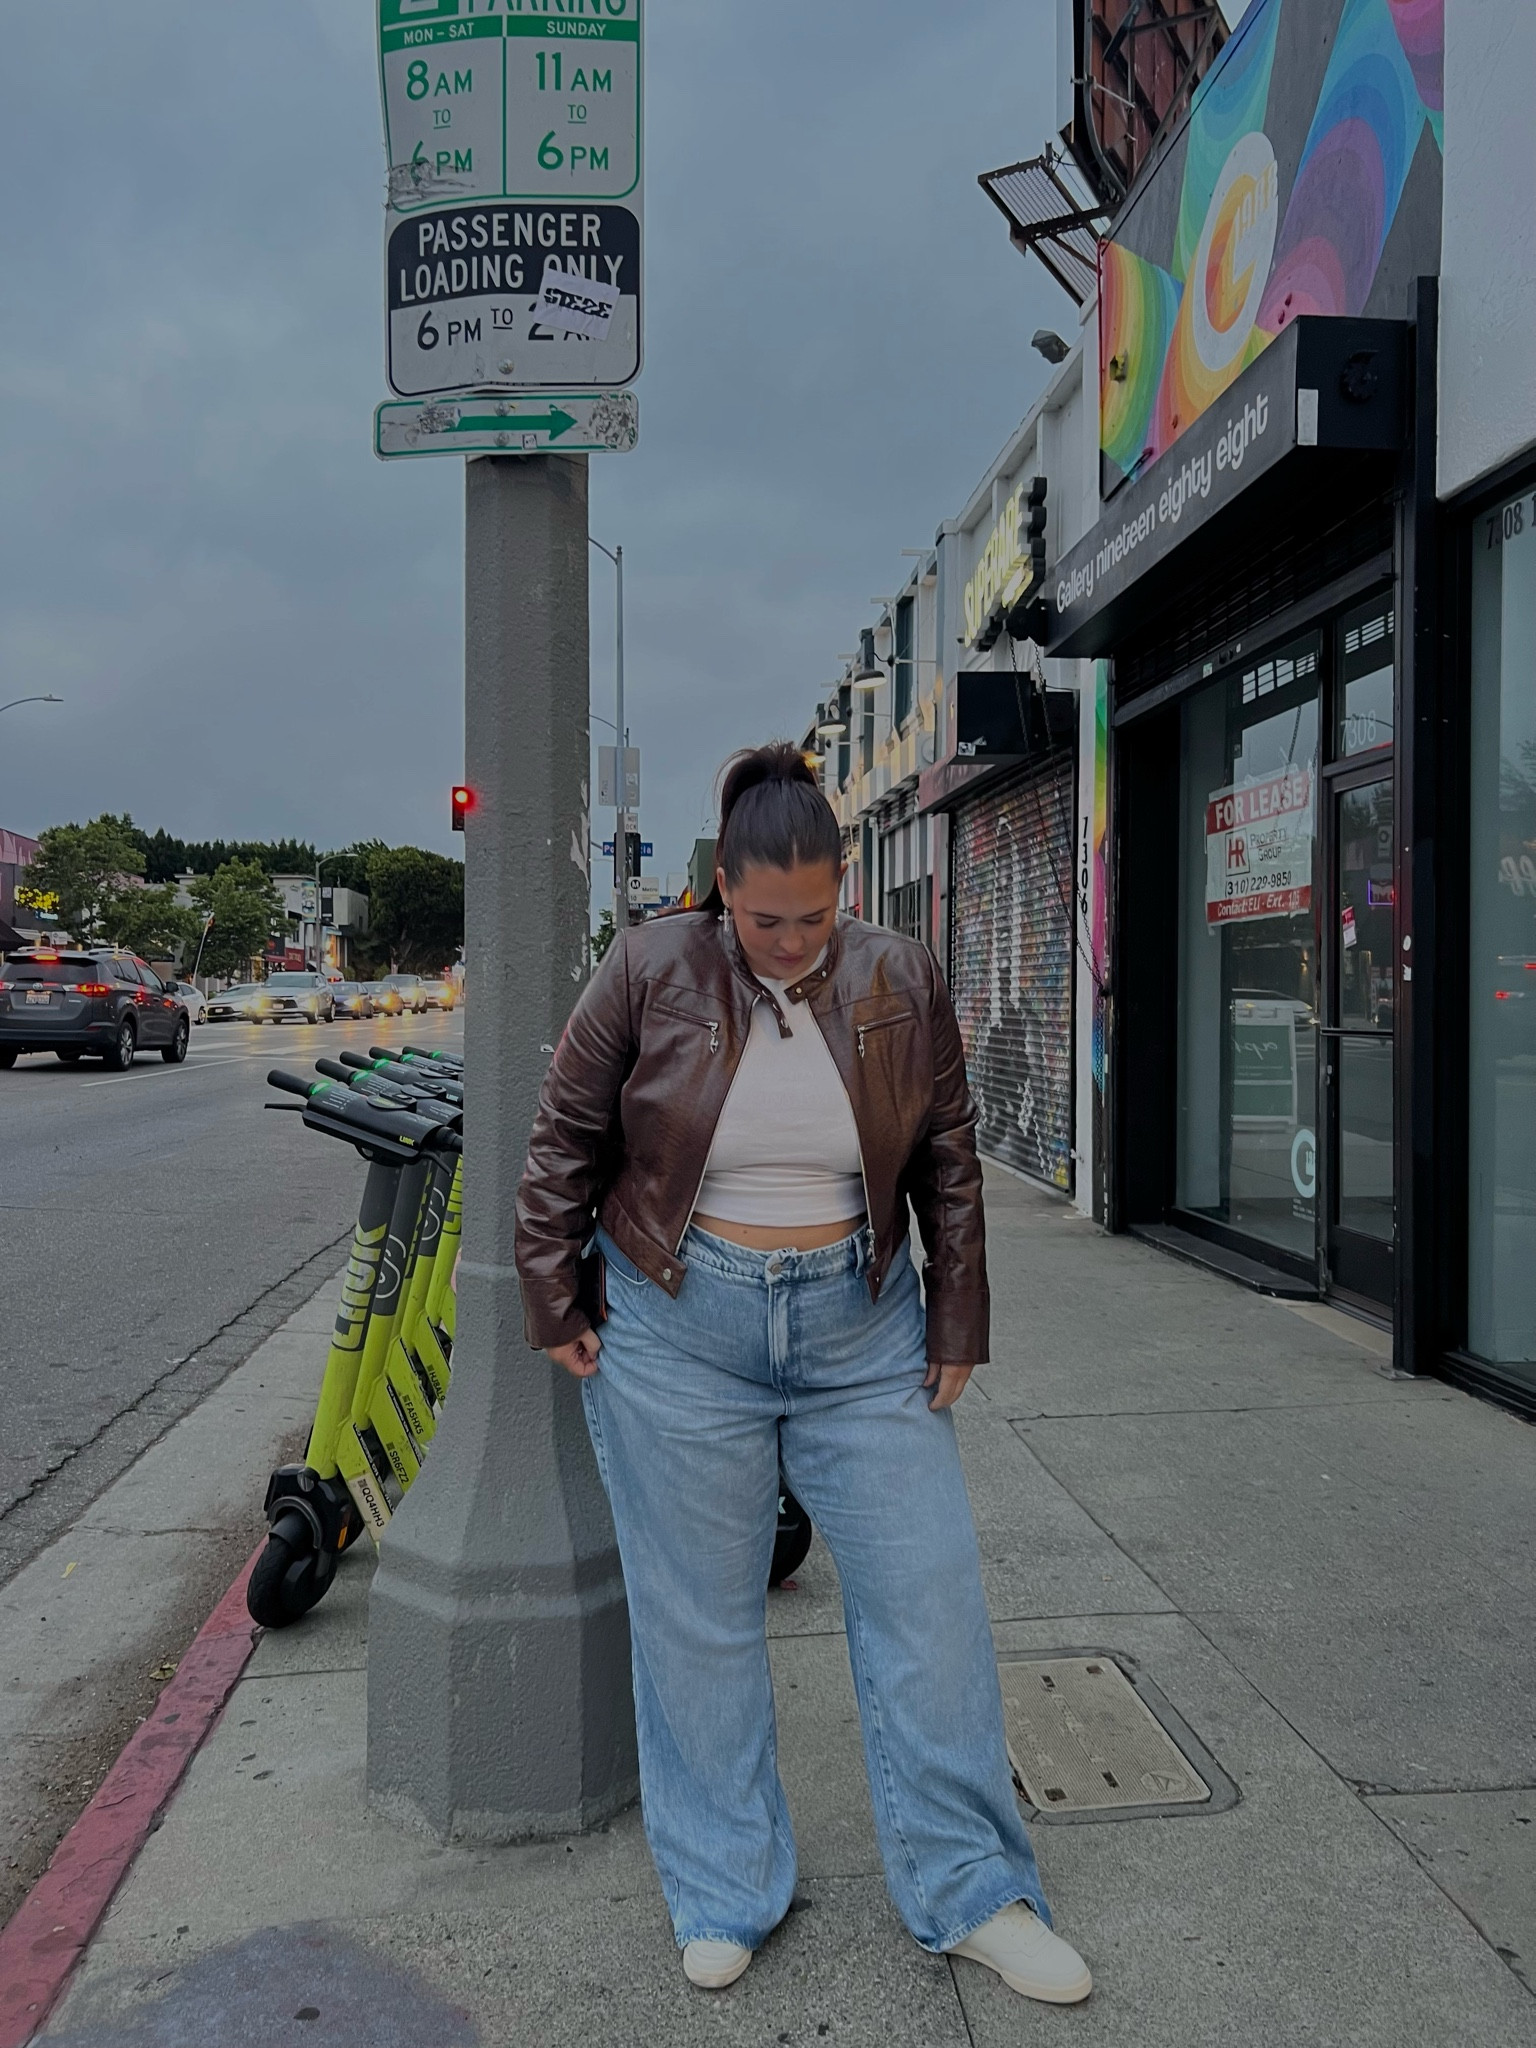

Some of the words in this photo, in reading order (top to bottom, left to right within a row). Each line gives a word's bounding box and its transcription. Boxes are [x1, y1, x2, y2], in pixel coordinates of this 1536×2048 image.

[404, 29, 433, 45] MON
[449, 22, 474, 38] SAT
[547, 20, 607, 37] SUNDAY
[407, 60, 430, 101] 8
[434, 69, 472, 97] AM
[536, 52, 562, 91] 11
[570, 68, 612, 93] AM
[433, 109, 451, 126] TO
[567, 104, 587, 120] TO
[436, 148, 472, 176] PM
[537, 130, 564, 171] 6
[570, 147, 609, 171] PM
[419, 212, 601, 257] PASSENGER
[401, 253, 524, 302] LOADING
[417, 310, 439, 350] 6
[447, 318, 482, 346] PM
[491, 308, 514, 326] TO
[1057, 562, 1094, 614] Gallery
[1096, 503, 1155, 579] nineteen
[1158, 449, 1212, 523] eighty
[1216, 393, 1268, 471] eight
[1340, 710, 1376, 752] 7308
[1215, 795, 1245, 830] FOR
[1250, 776, 1304, 819] LEASE
[1258, 848, 1282, 862] GROUP
[389, 1450, 410, 1485] SR6FZ2
[362, 1487, 385, 1528] QQ4HH3
